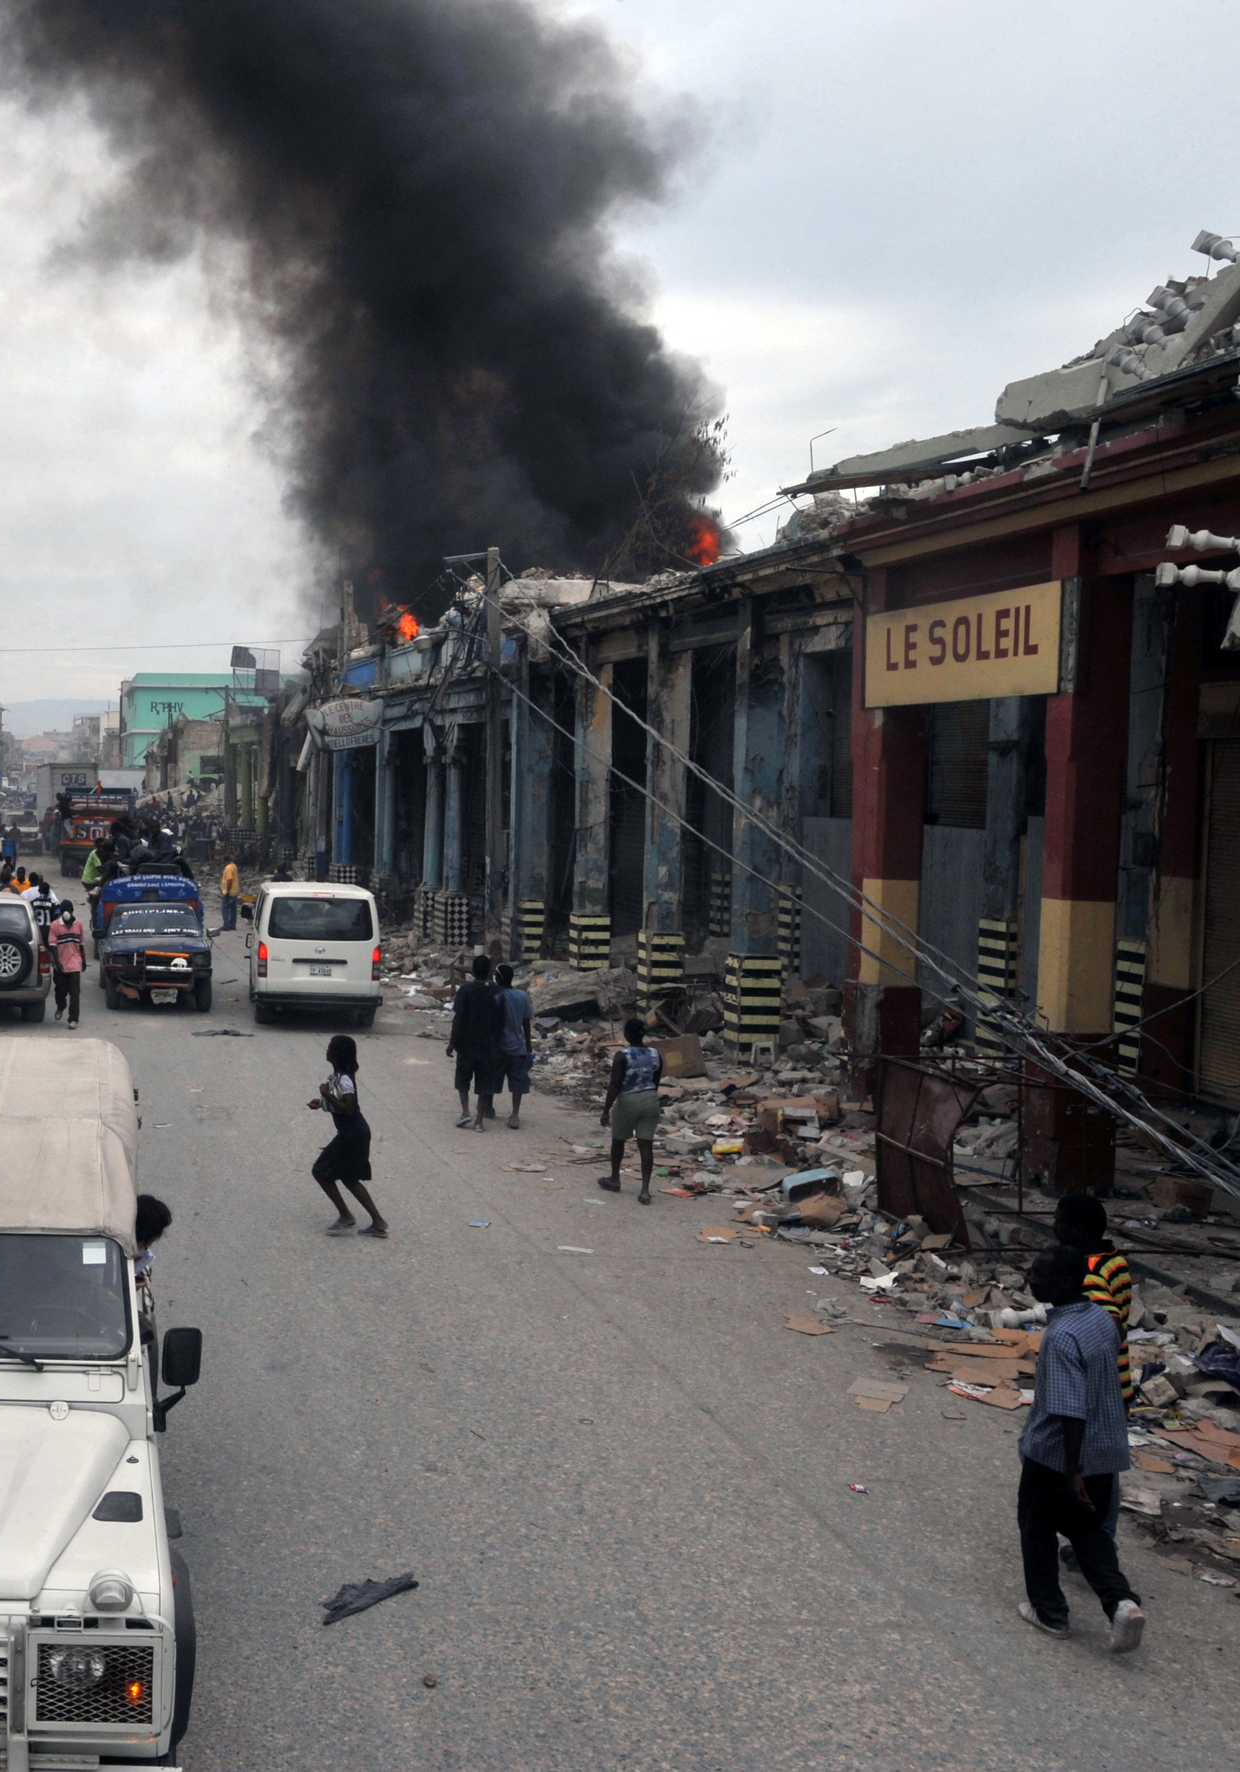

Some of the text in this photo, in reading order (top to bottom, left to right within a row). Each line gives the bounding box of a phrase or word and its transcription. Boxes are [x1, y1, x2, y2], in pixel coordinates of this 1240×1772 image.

[886, 604, 1039, 672] LE SOLEIL
[323, 700, 364, 717] LE CENTRE
[338, 713, 353, 724] DES
[63, 775, 85, 783] CTS
